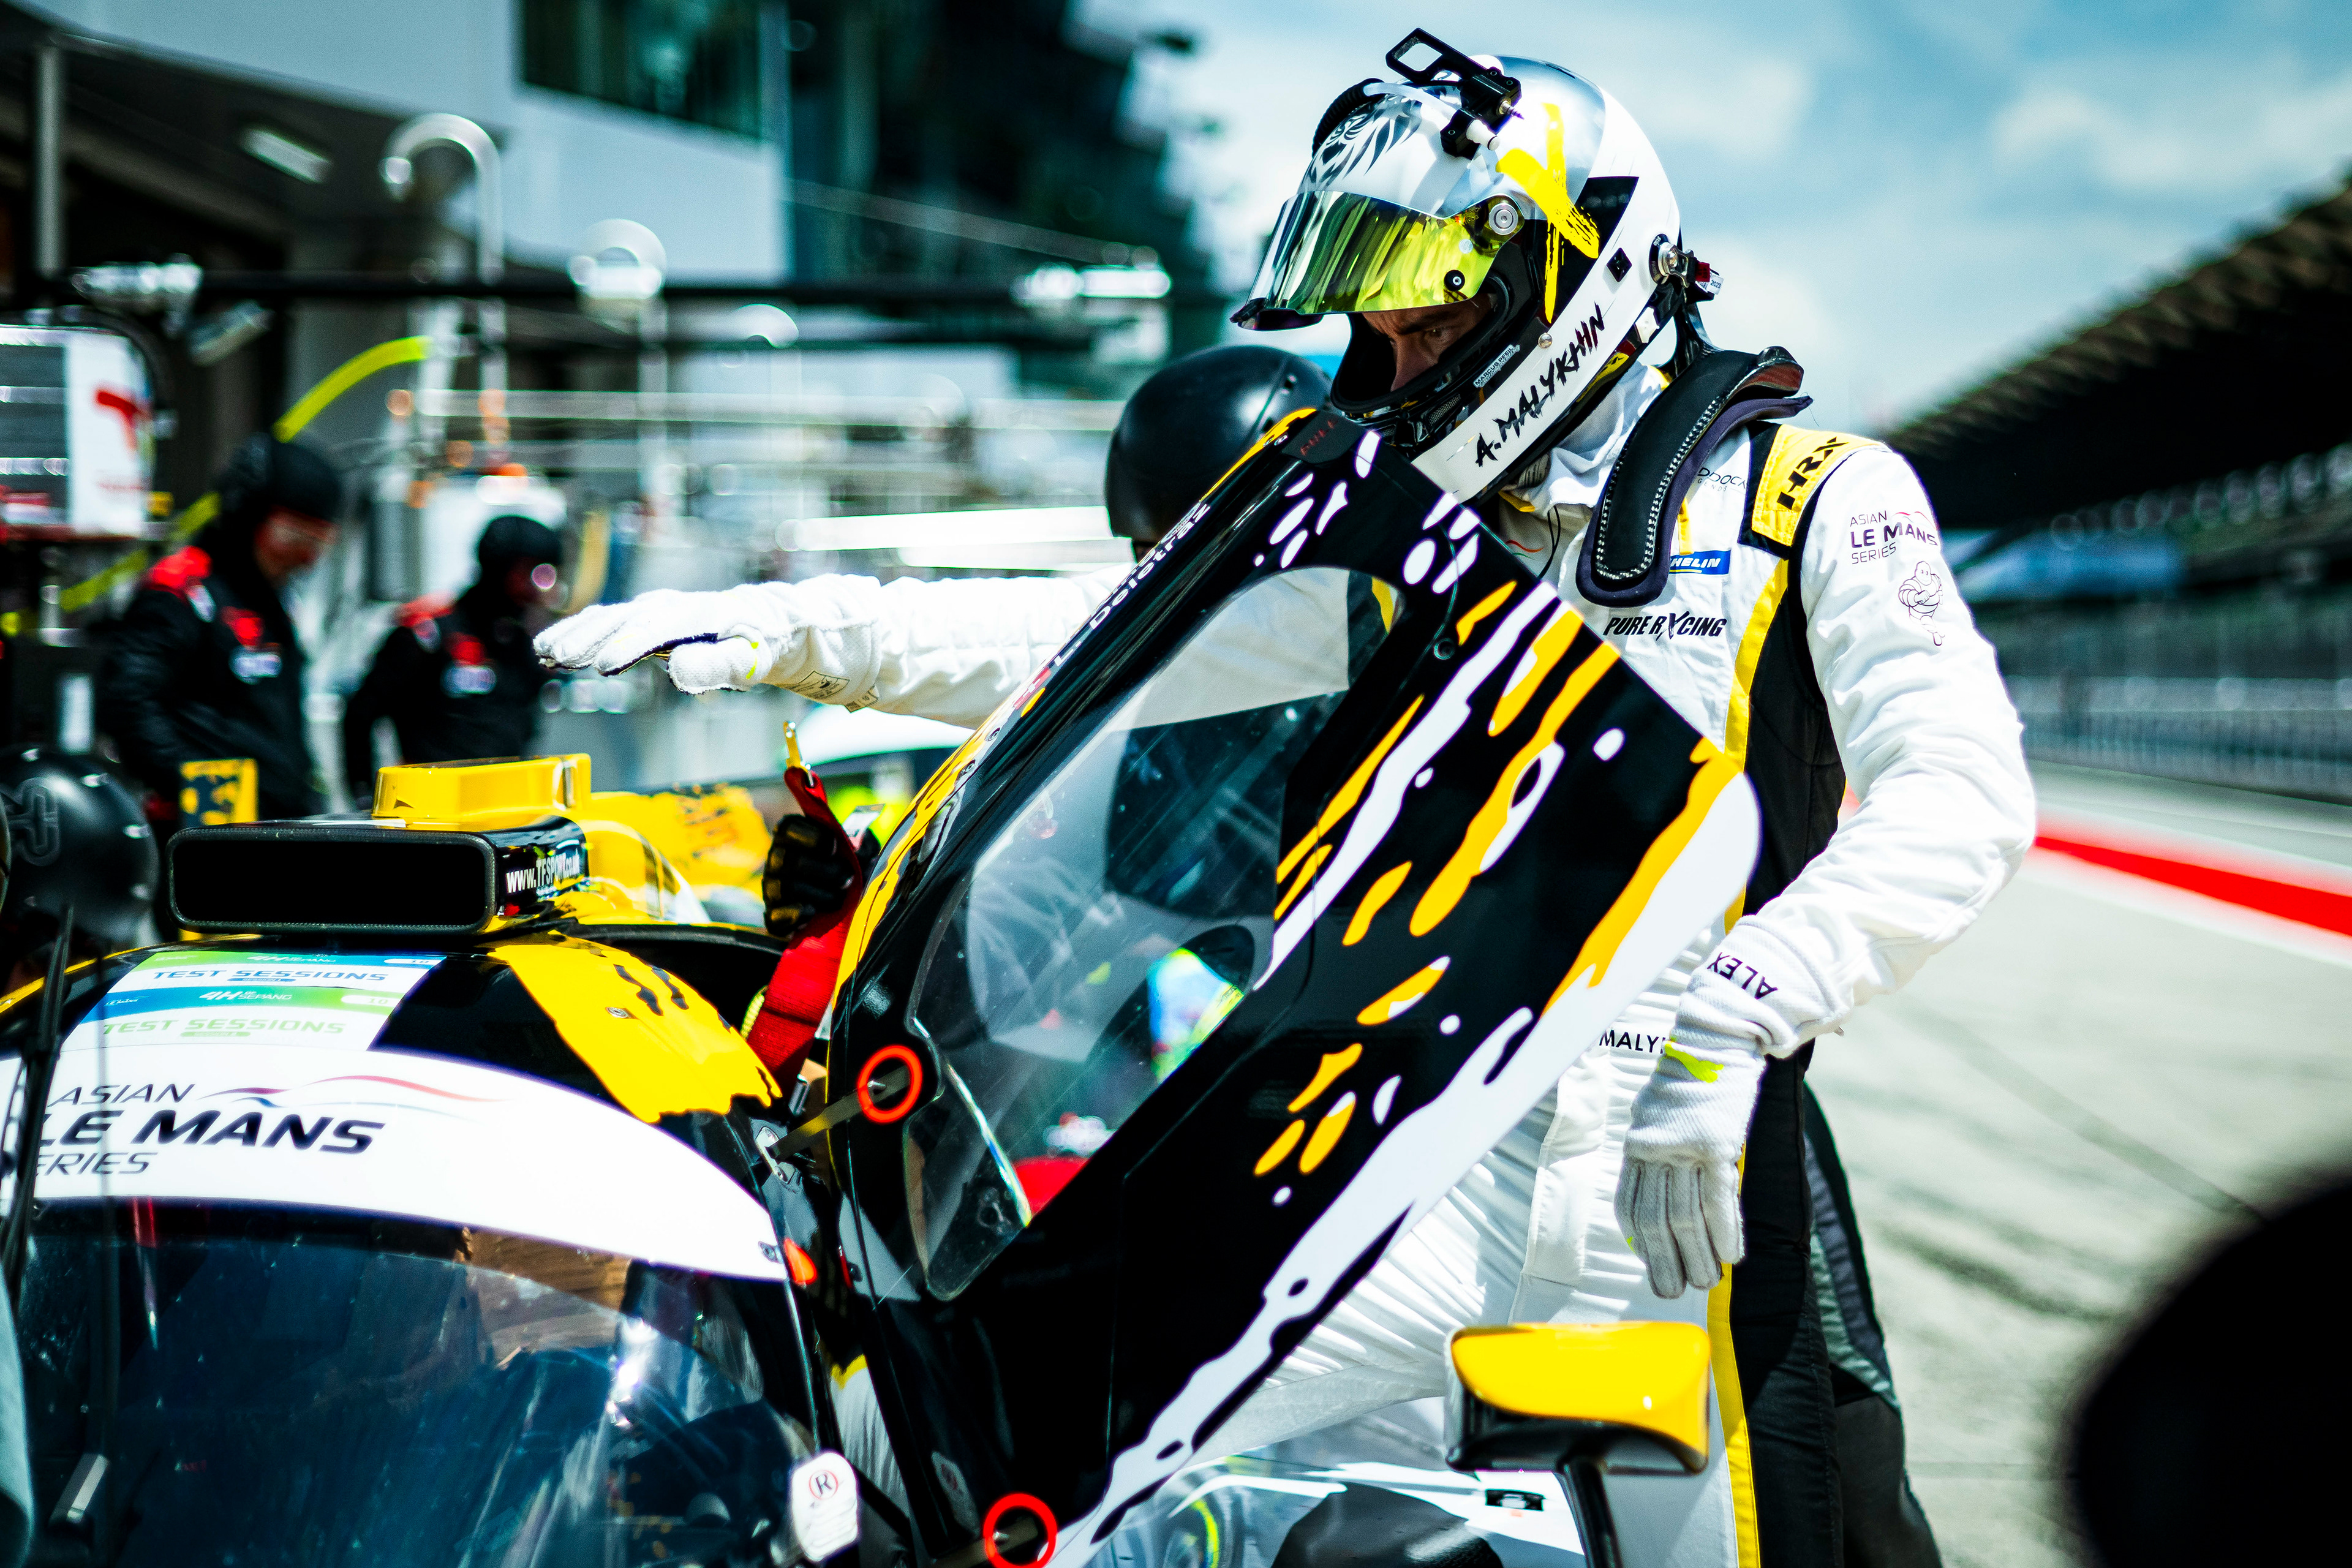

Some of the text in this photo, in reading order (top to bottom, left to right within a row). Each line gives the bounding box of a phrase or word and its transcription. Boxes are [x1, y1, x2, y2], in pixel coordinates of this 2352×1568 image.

[1711, 279, 1722, 290] 2023
[1475, 347, 1513, 386] MARCUS PFEIL
[1776, 437, 1849, 510] HRX
[1850, 510, 1888, 527] ASIAN
[1850, 522, 1938, 548] LE MANS
[1670, 557, 1721, 568] HELIN
[1852, 542, 1896, 564] SERIES
[1090, 504, 1210, 630] Deletraz
[1603, 616, 1653, 636] PURE
[154, 970, 388, 981] TEST SESSIONS
[1707, 952, 1779, 1000] ALEX
[199, 991, 243, 1000] 4H
[103, 1019, 346, 1035] TEST SESSIONS
[47, 1084, 195, 1107] ASIAN
[130, 1109, 386, 1155] MANS
